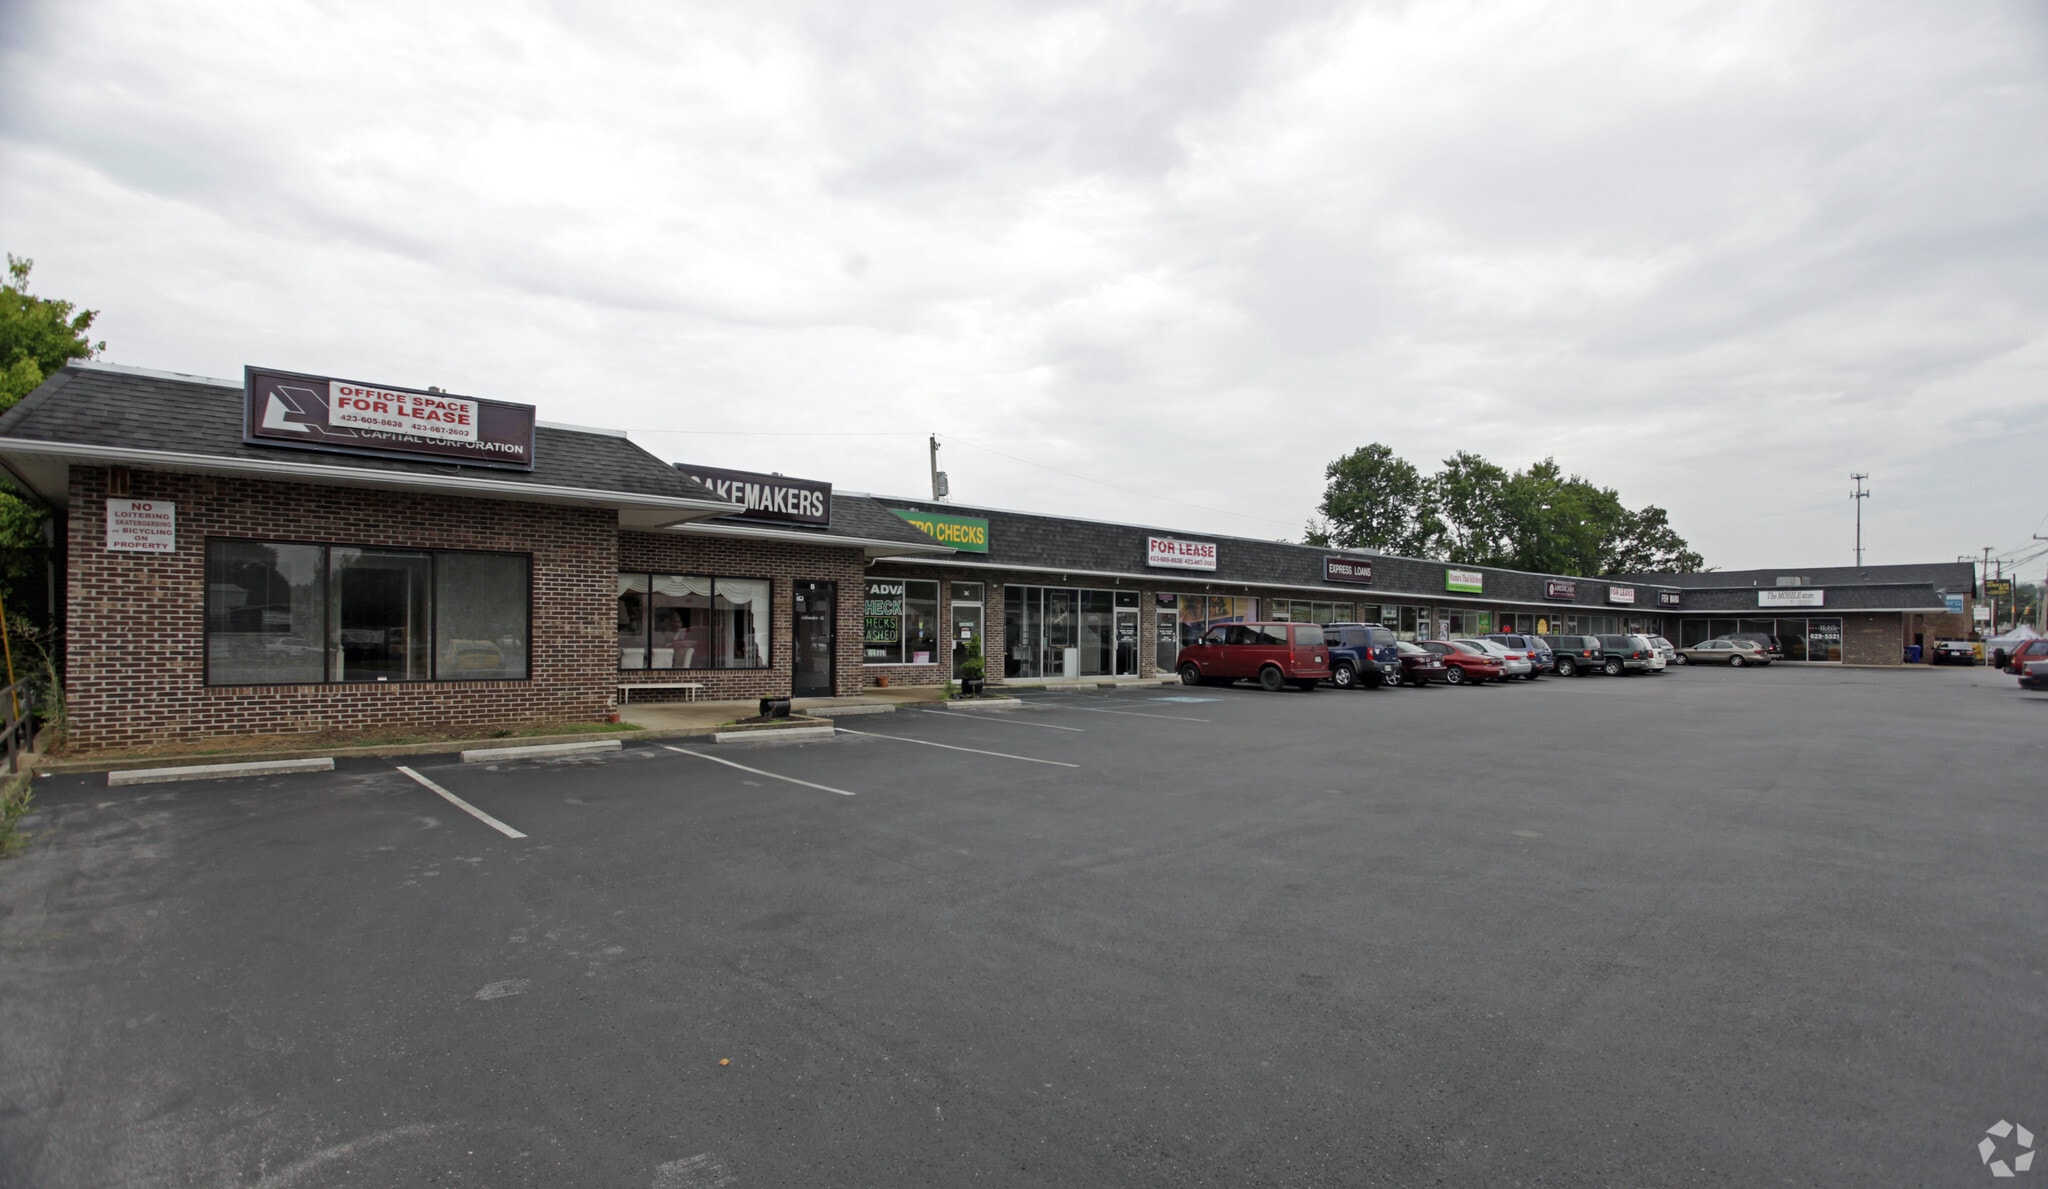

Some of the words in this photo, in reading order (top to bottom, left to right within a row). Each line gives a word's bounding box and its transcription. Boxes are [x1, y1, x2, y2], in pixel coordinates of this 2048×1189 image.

[339, 386, 407, 404] OFFICE
[413, 396, 470, 413] SPACE
[338, 397, 389, 415] FOR
[397, 406, 471, 426] LEASE
[340, 414, 403, 429] 423-605-8638
[410, 422, 470, 437] 423-667-2603
[360, 428, 423, 444] CAPITAL
[690, 475, 824, 518] KEMAKERS
[131, 502, 153, 512] NO
[114, 511, 170, 520] LOITERING
[115, 519, 172, 528] SKATEBOARDING
[122, 527, 173, 536] BICYCLING
[936, 522, 985, 546] CHECKS
[113, 541, 169, 549] PROPERTY
[1150, 539, 1176, 555] FOR
[1178, 543, 1215, 558] LEASE
[1329, 563, 1353, 576] EXPRESS
[1354, 565, 1372, 577] LOANS
[1610, 587, 1619, 596] FOR
[1620, 588, 1634, 597] LEASE
[864, 600, 903, 616] HECK
[866, 617, 896, 629] HECKS
[866, 630, 896, 641] ASHED
